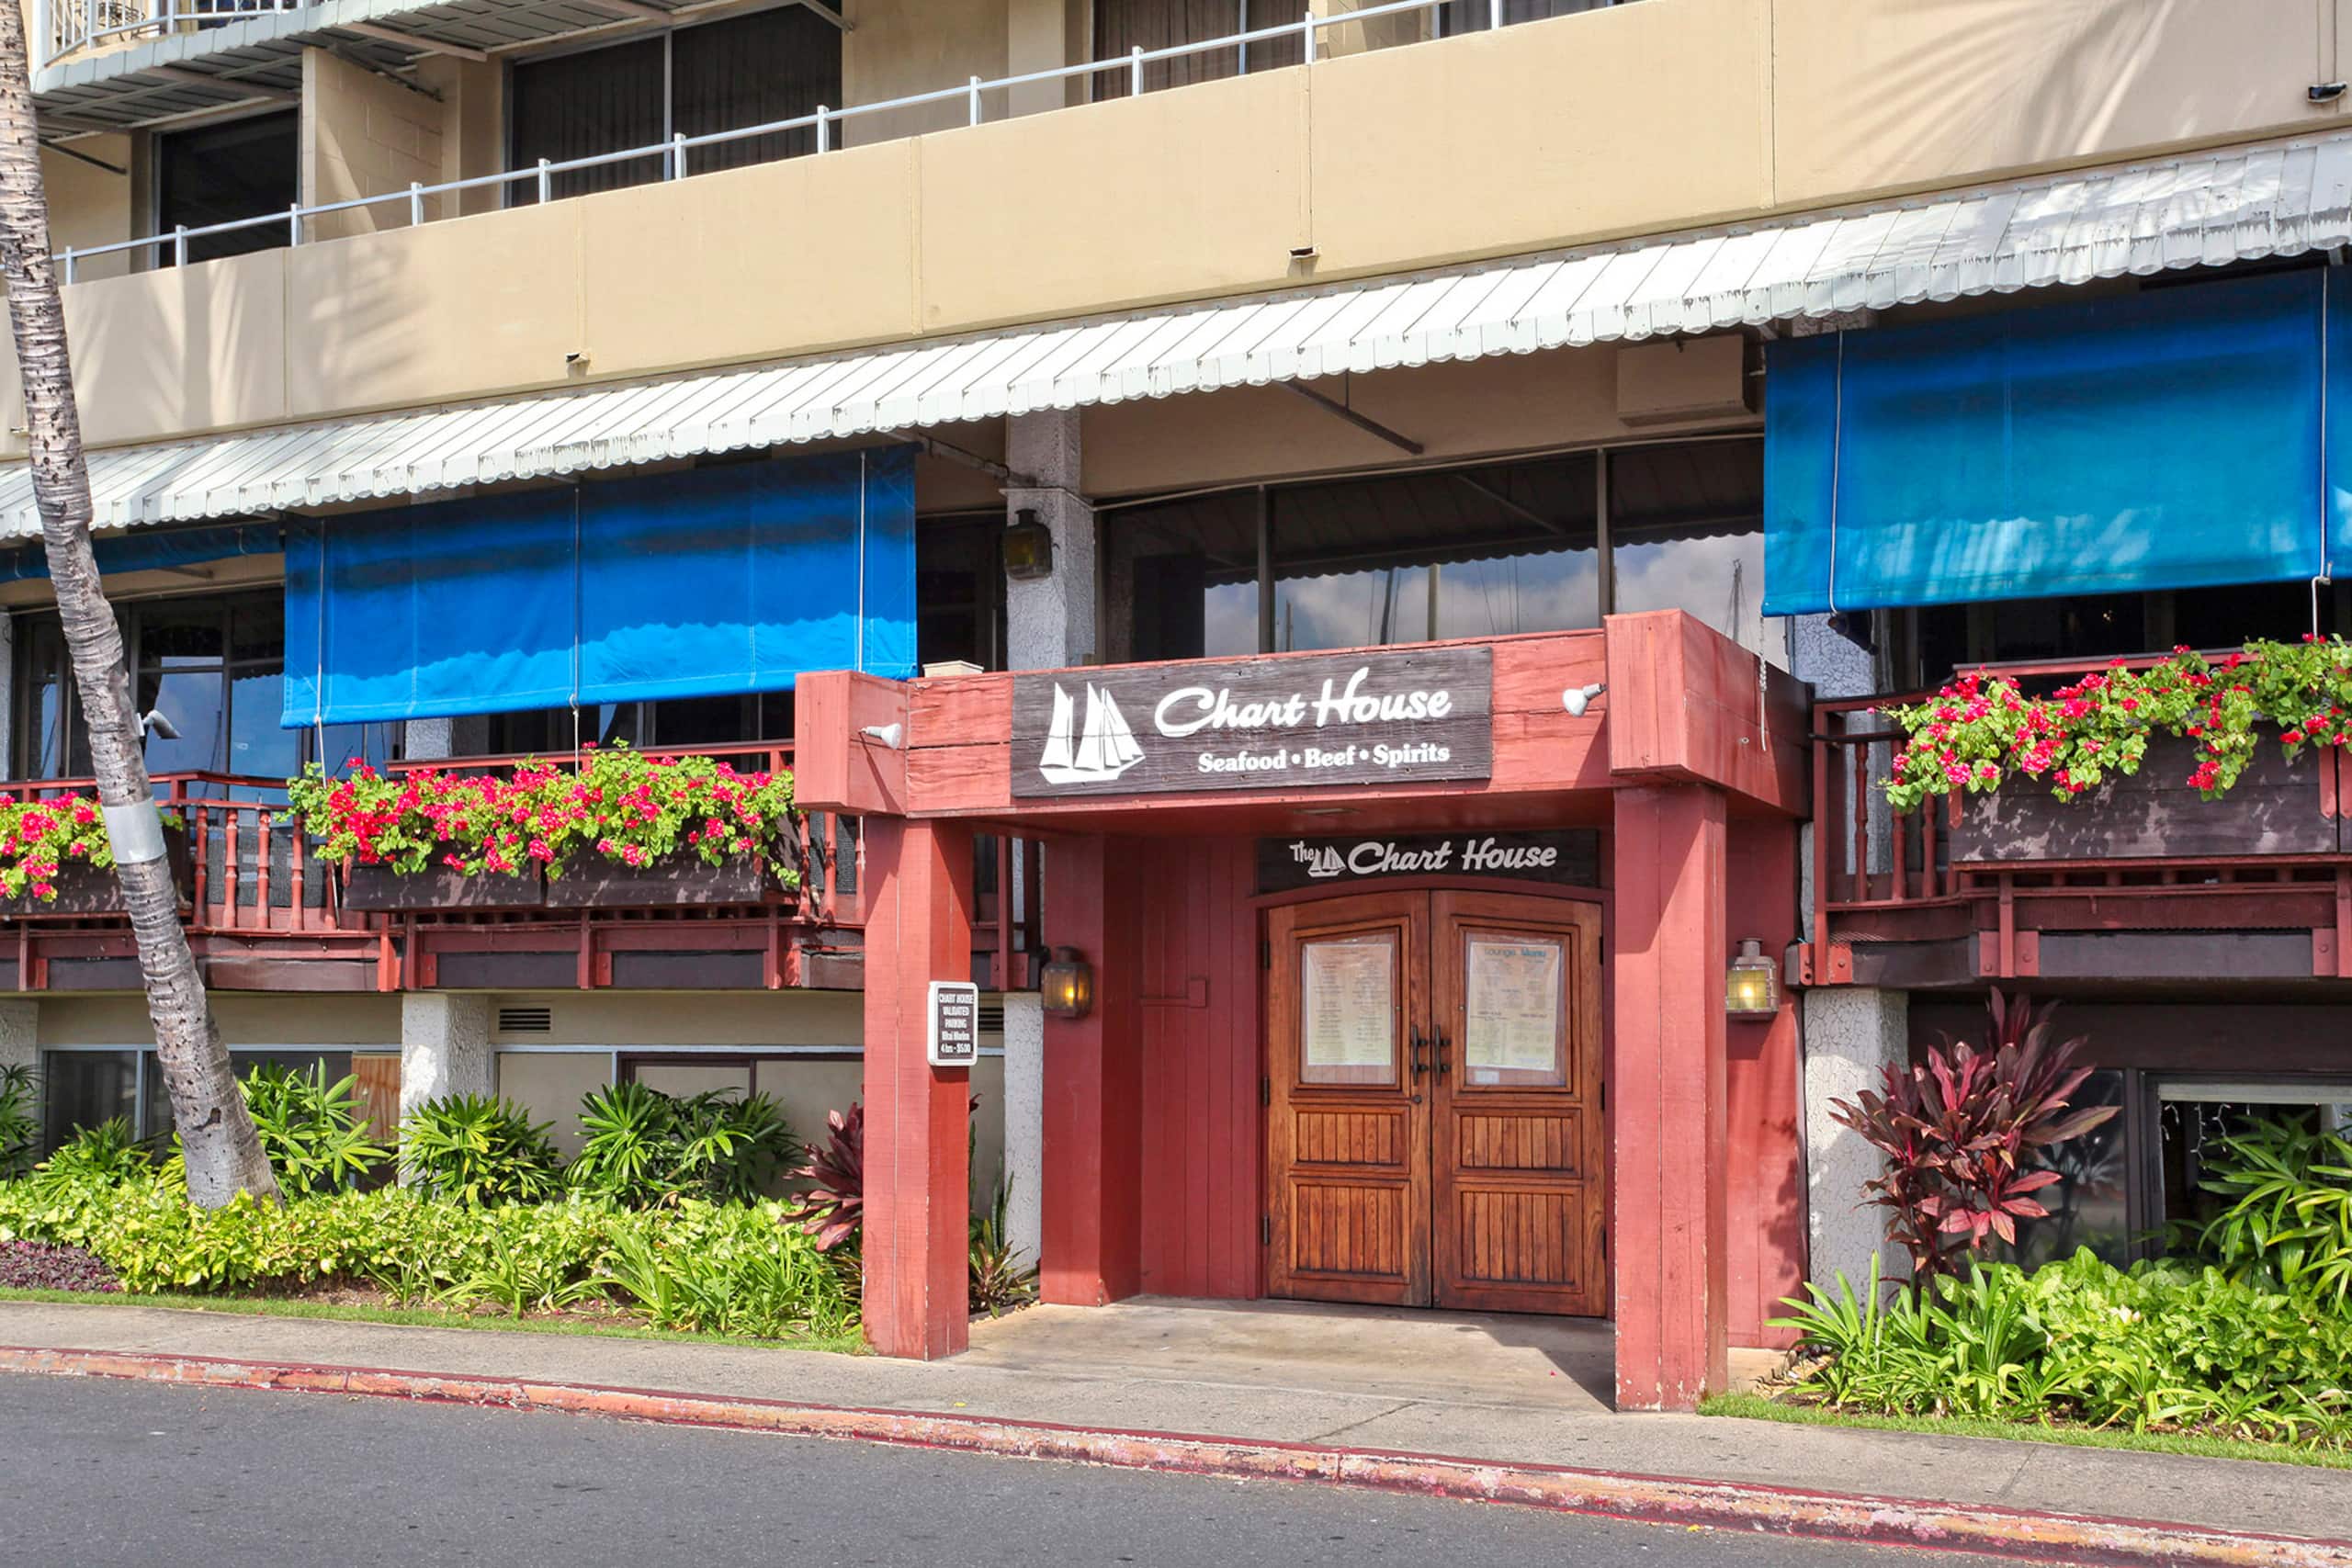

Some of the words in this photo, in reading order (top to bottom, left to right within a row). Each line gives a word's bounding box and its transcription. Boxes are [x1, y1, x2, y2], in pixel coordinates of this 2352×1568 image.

[1154, 685, 1307, 738] Chart
[1310, 666, 1453, 728] House
[1197, 749, 1288, 774] Seafood
[1304, 744, 1356, 769] Beef
[1372, 742, 1451, 769] Spirits
[1289, 840, 1314, 863] The
[1347, 840, 1453, 874] Chart
[1461, 837, 1557, 871] House
[939, 993, 956, 1003] CHART
[956, 993, 975, 1004] HOUSE
